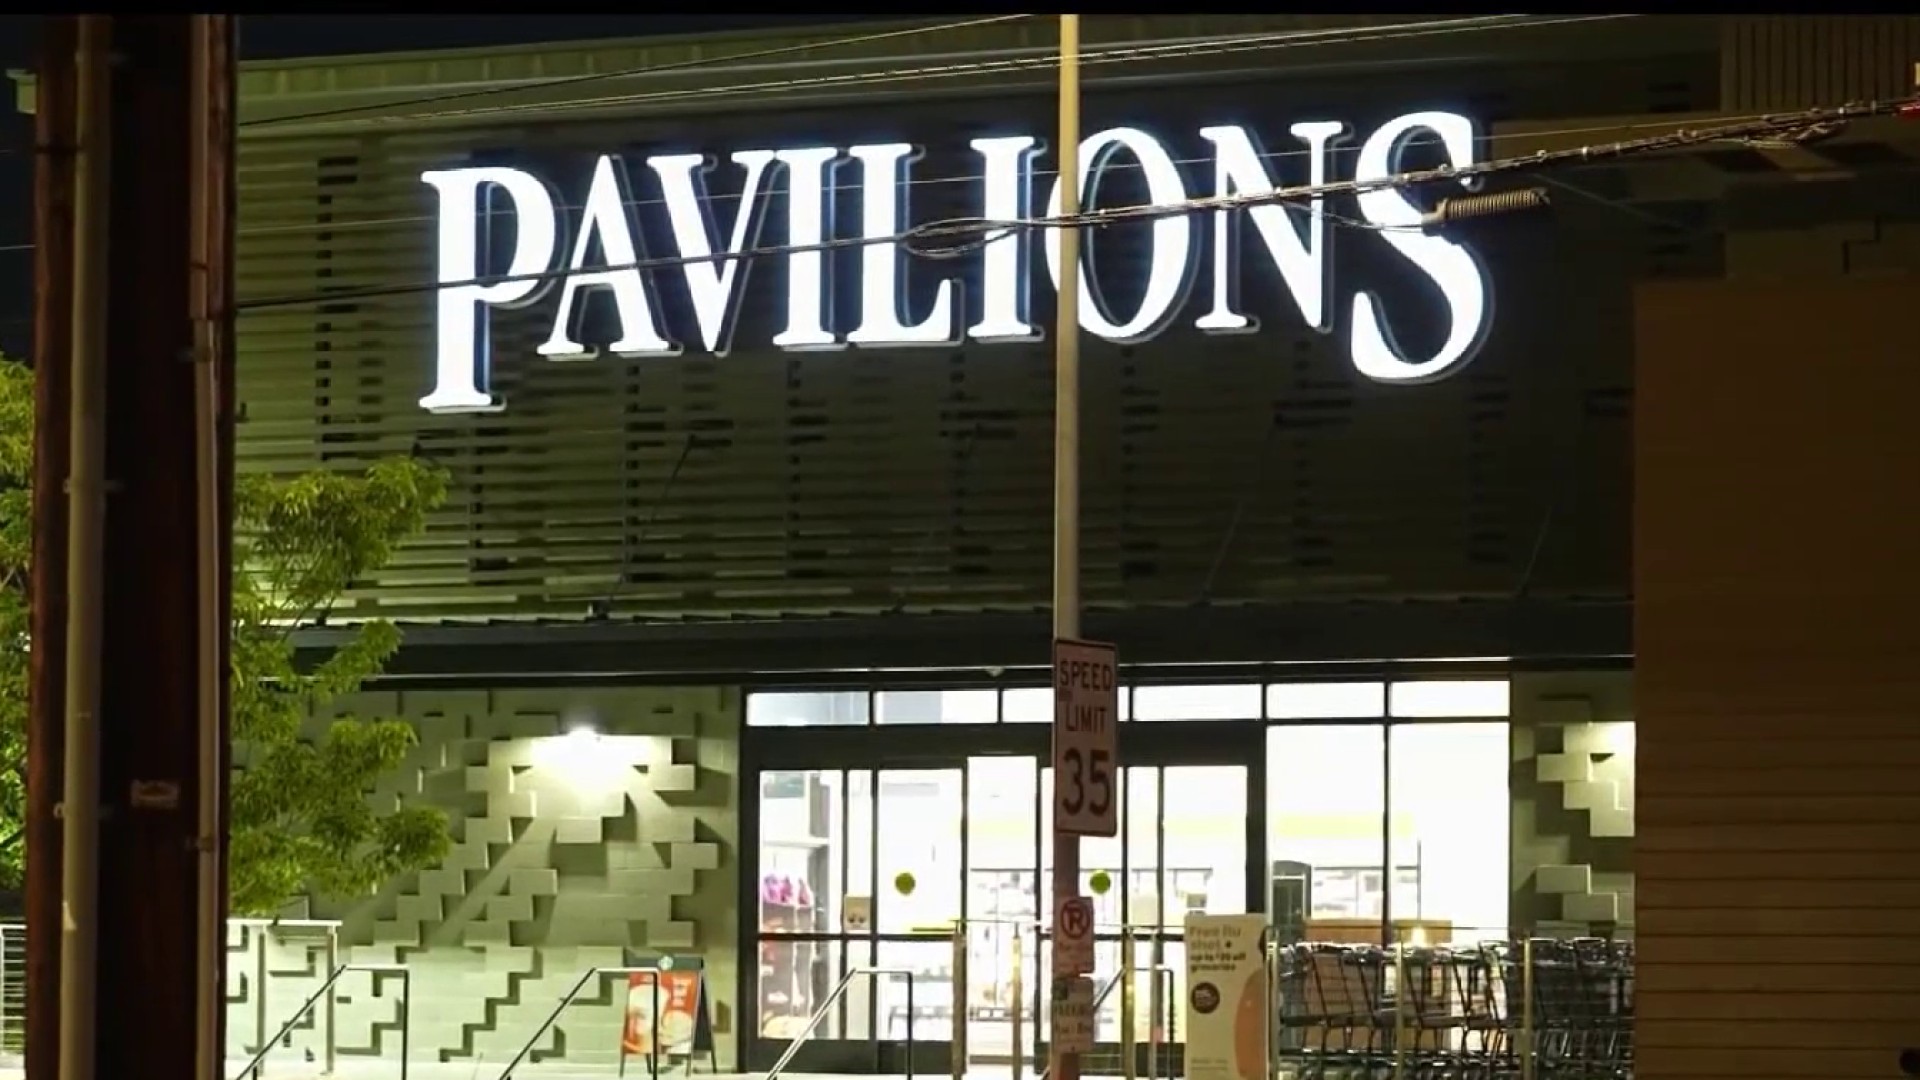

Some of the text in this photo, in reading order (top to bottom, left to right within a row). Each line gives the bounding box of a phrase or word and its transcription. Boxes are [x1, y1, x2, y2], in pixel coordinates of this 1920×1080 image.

[418, 111, 1491, 412] PAVILIONS
[1060, 660, 1113, 691] SPEED
[1066, 703, 1107, 732] LIMIT
[1062, 747, 1110, 816] 35
